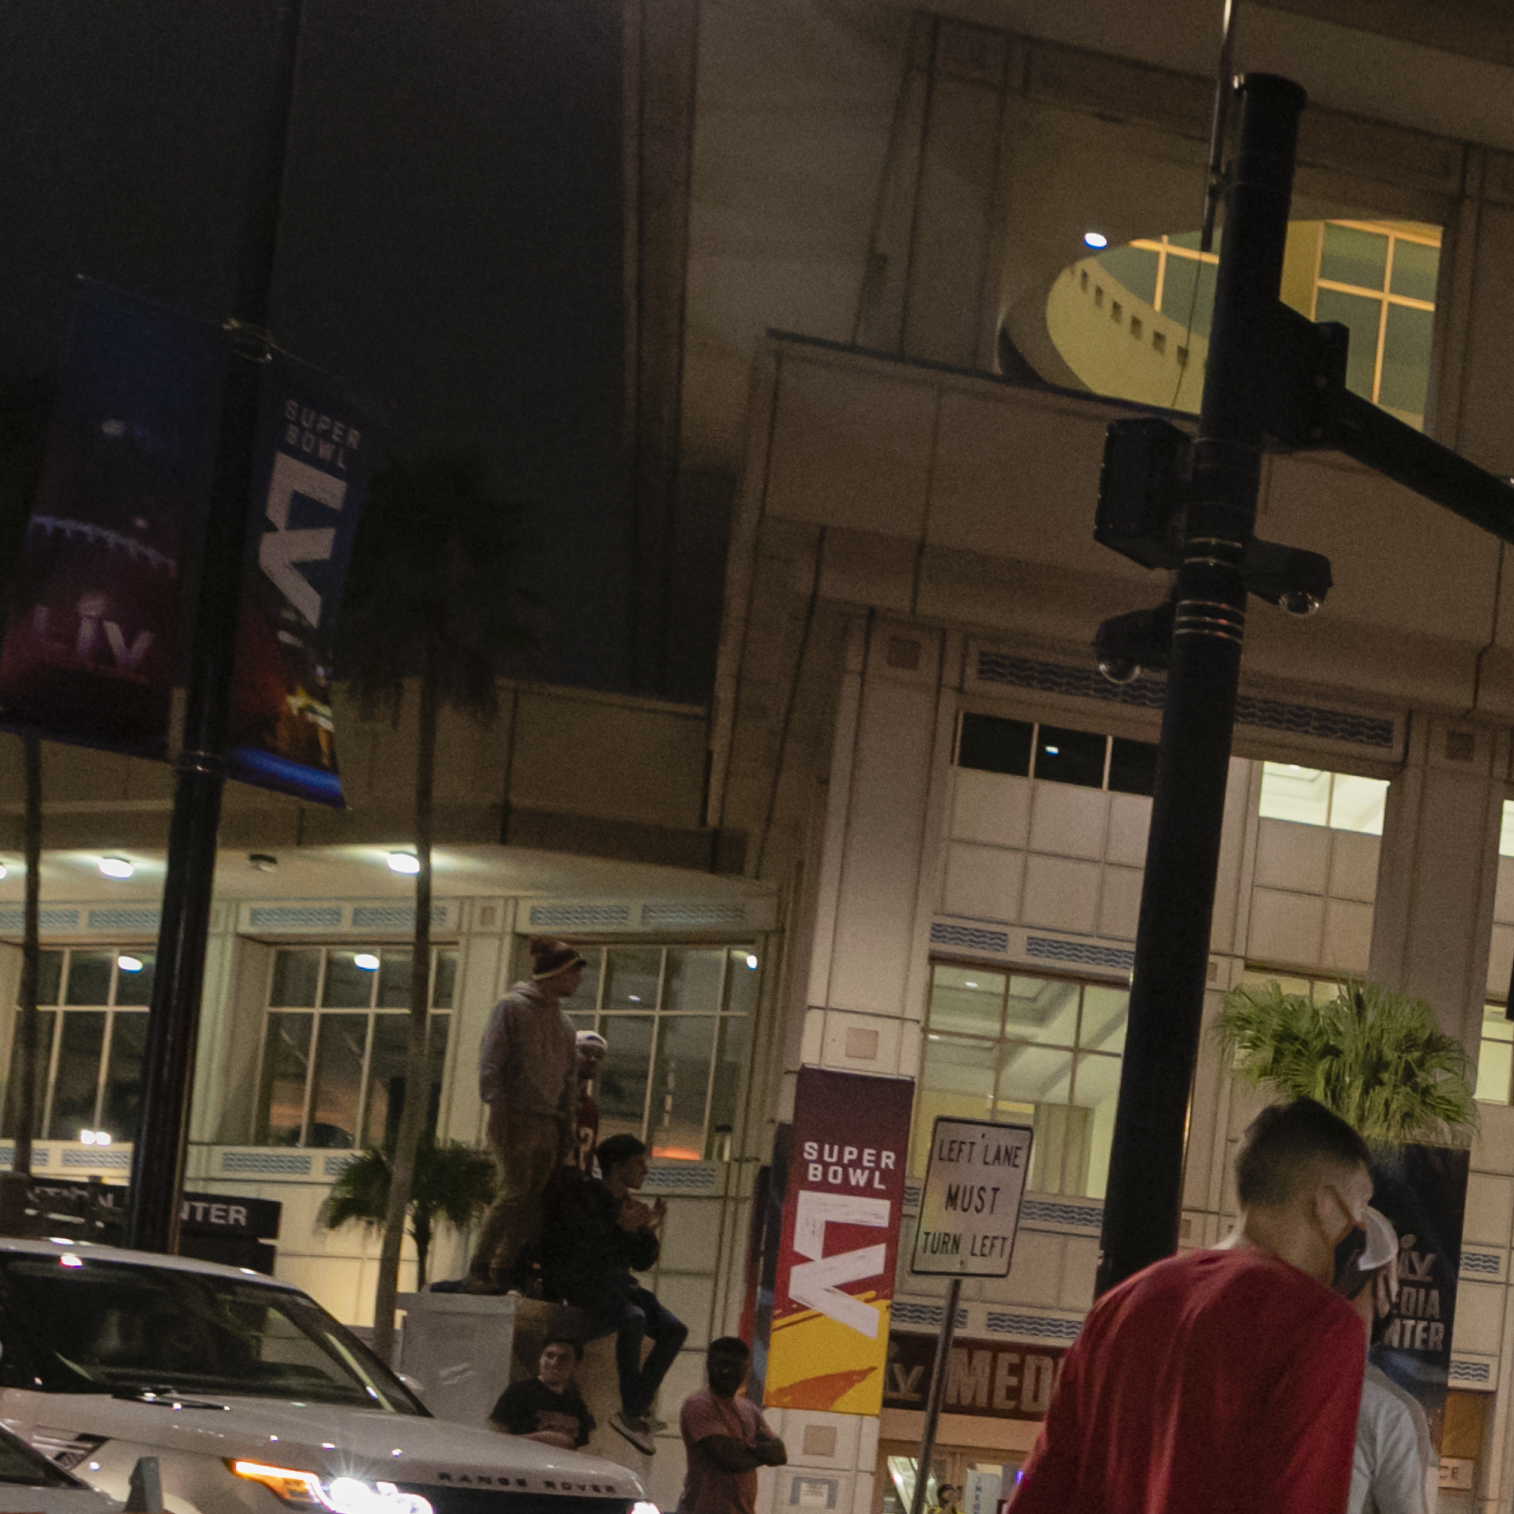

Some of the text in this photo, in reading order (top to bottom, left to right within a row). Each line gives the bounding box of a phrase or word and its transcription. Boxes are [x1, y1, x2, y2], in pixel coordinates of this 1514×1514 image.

[286, 400, 360, 450] SUPER
[286, 423, 346, 471] BOWL
[803, 1141, 896, 1171] SUPER
[937, 1139, 1022, 1168] LEFT LANE
[807, 1162, 887, 1191] BOWL
[180, 1200, 248, 1226] NTER
[944, 1183, 1000, 1215] MUST
[923, 1231, 1008, 1259] TURN LEFT
[1401, 1286, 1441, 1319] DIA
[1384, 1318, 1446, 1351] NTER
[437, 1472, 616, 1493] RANGE ROVER
